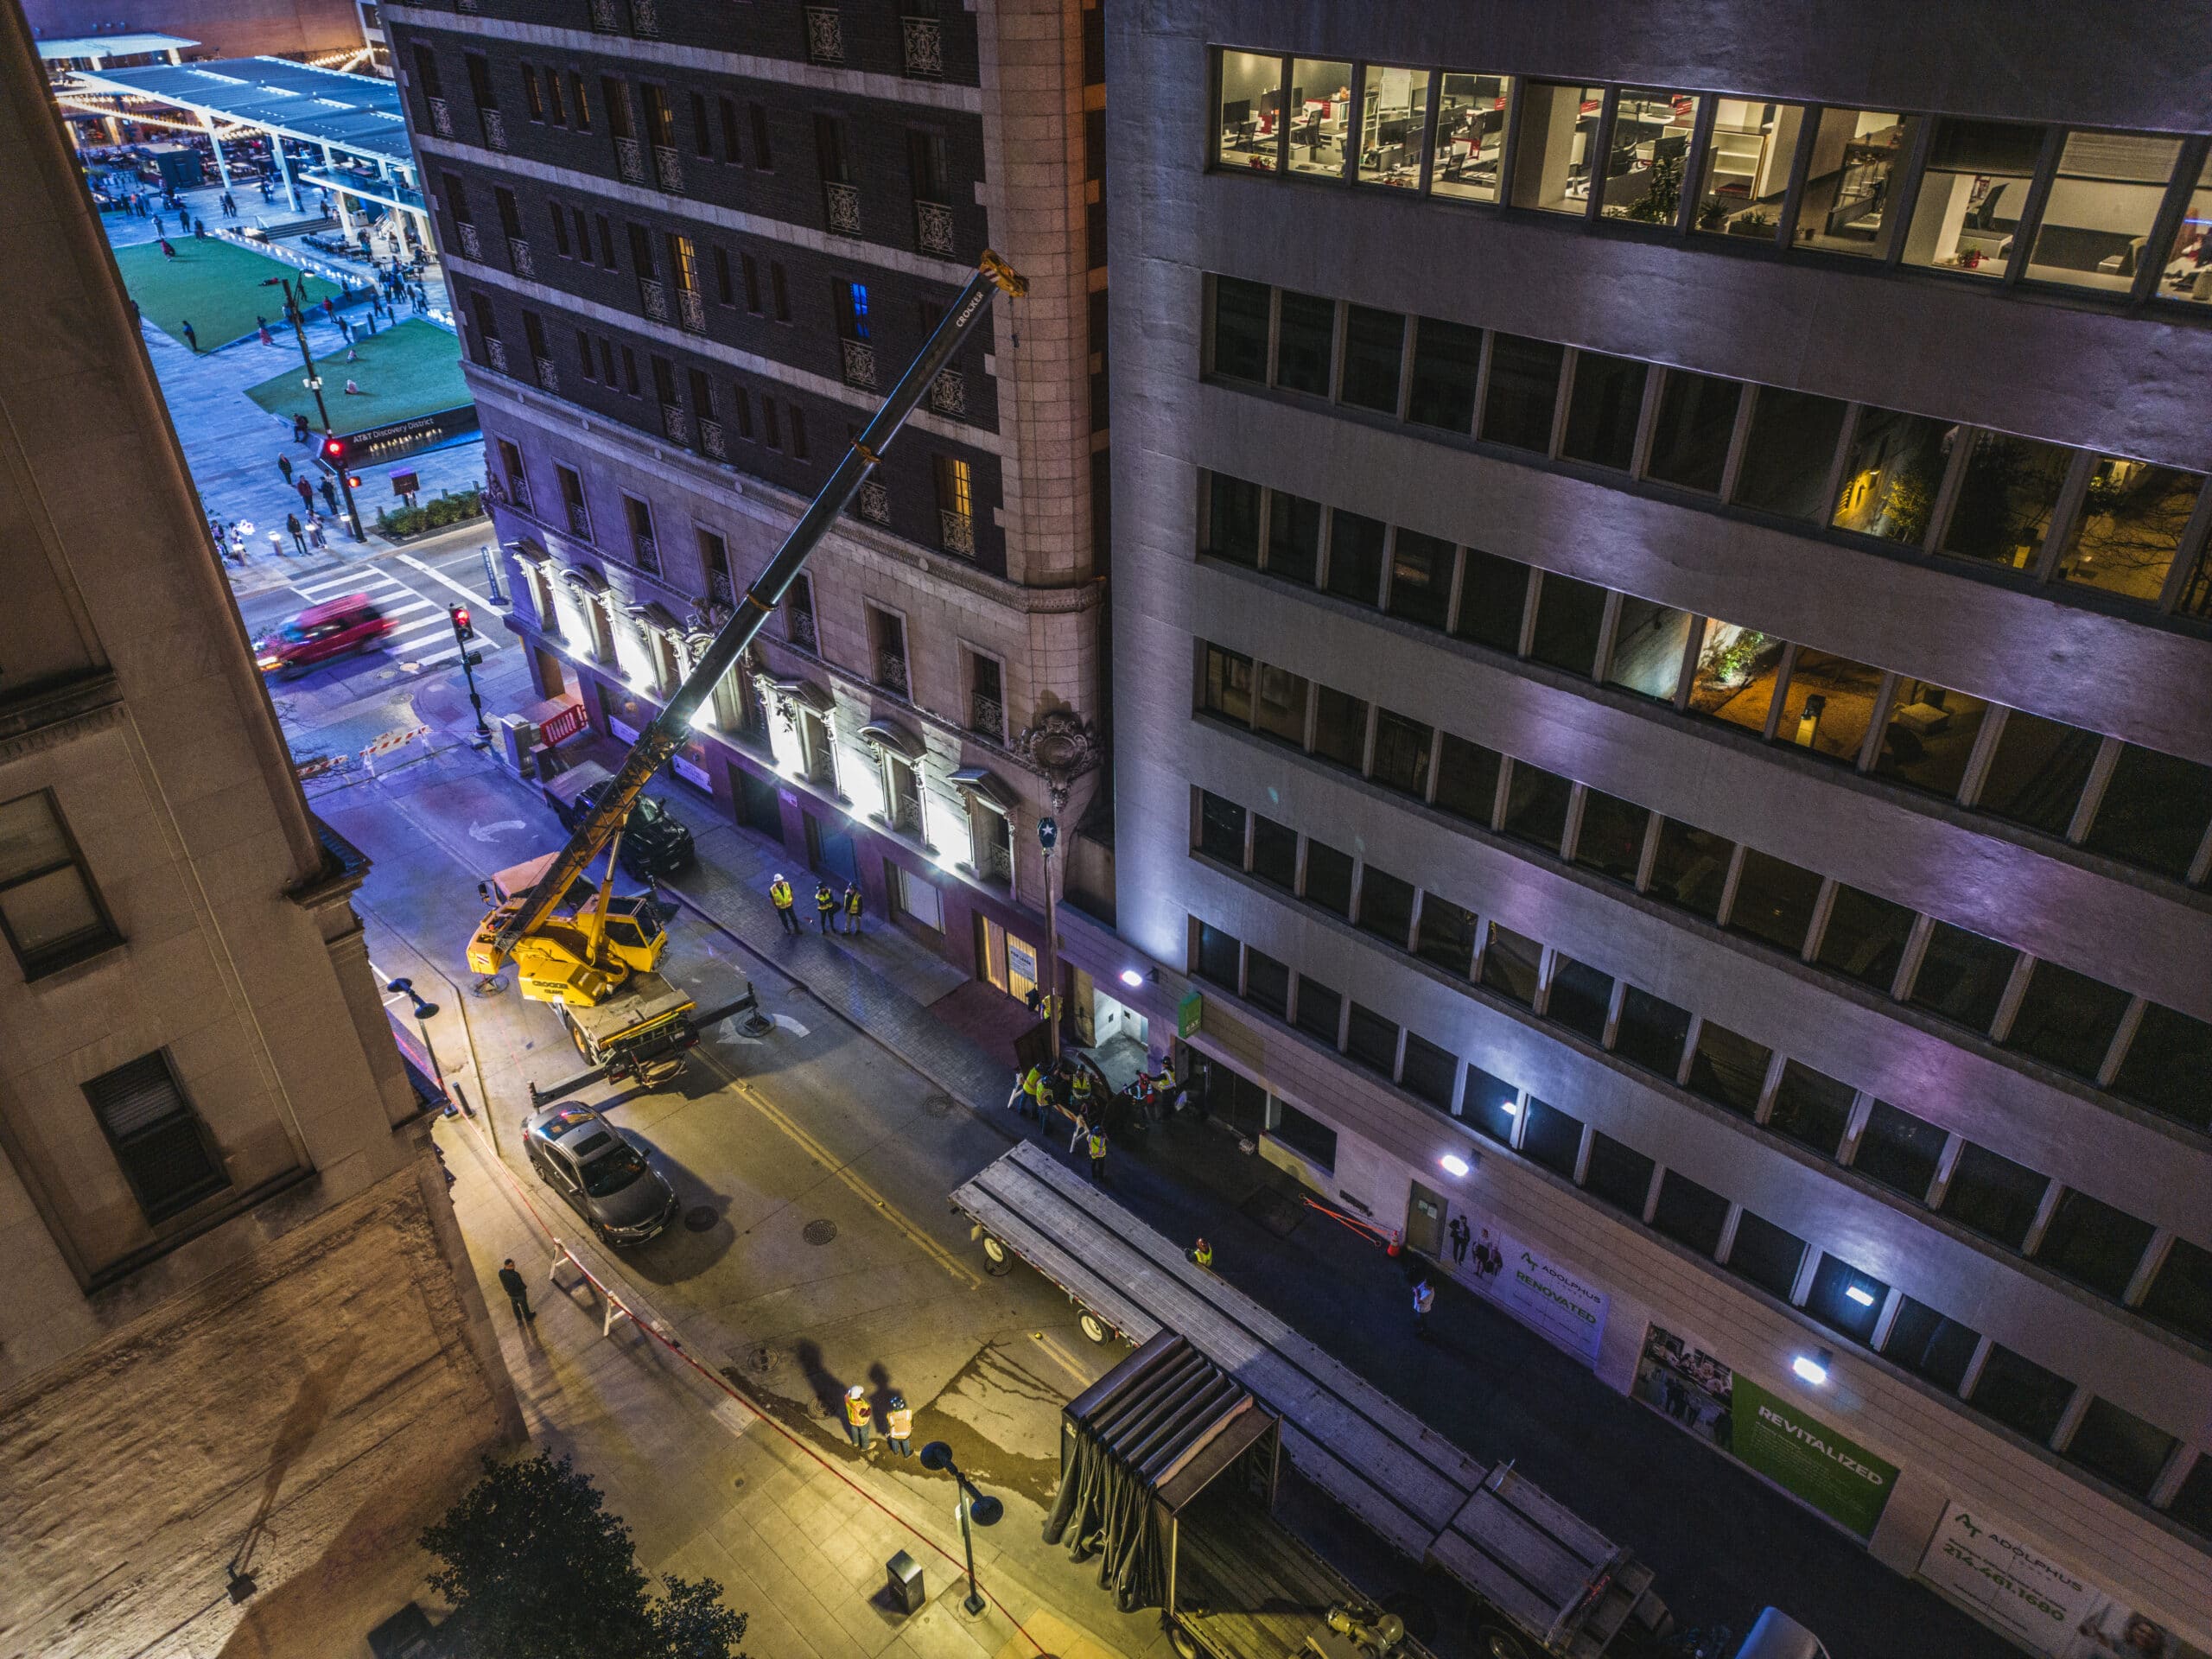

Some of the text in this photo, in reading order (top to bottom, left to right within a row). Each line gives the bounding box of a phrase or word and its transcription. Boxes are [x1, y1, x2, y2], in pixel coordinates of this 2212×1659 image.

[956, 291, 984, 327] CROCKER
[353, 417, 434, 442] AT&T Discovery District
[1516, 1269, 1597, 1324] RENOVATED
[1541, 1265, 1601, 1304] ADOLPHUS
[1758, 1405, 1884, 1486] REVITALIZED
[1942, 1542, 2065, 1622] 214.461.1680
[1988, 1534, 2083, 1592] ADOLPHUS
